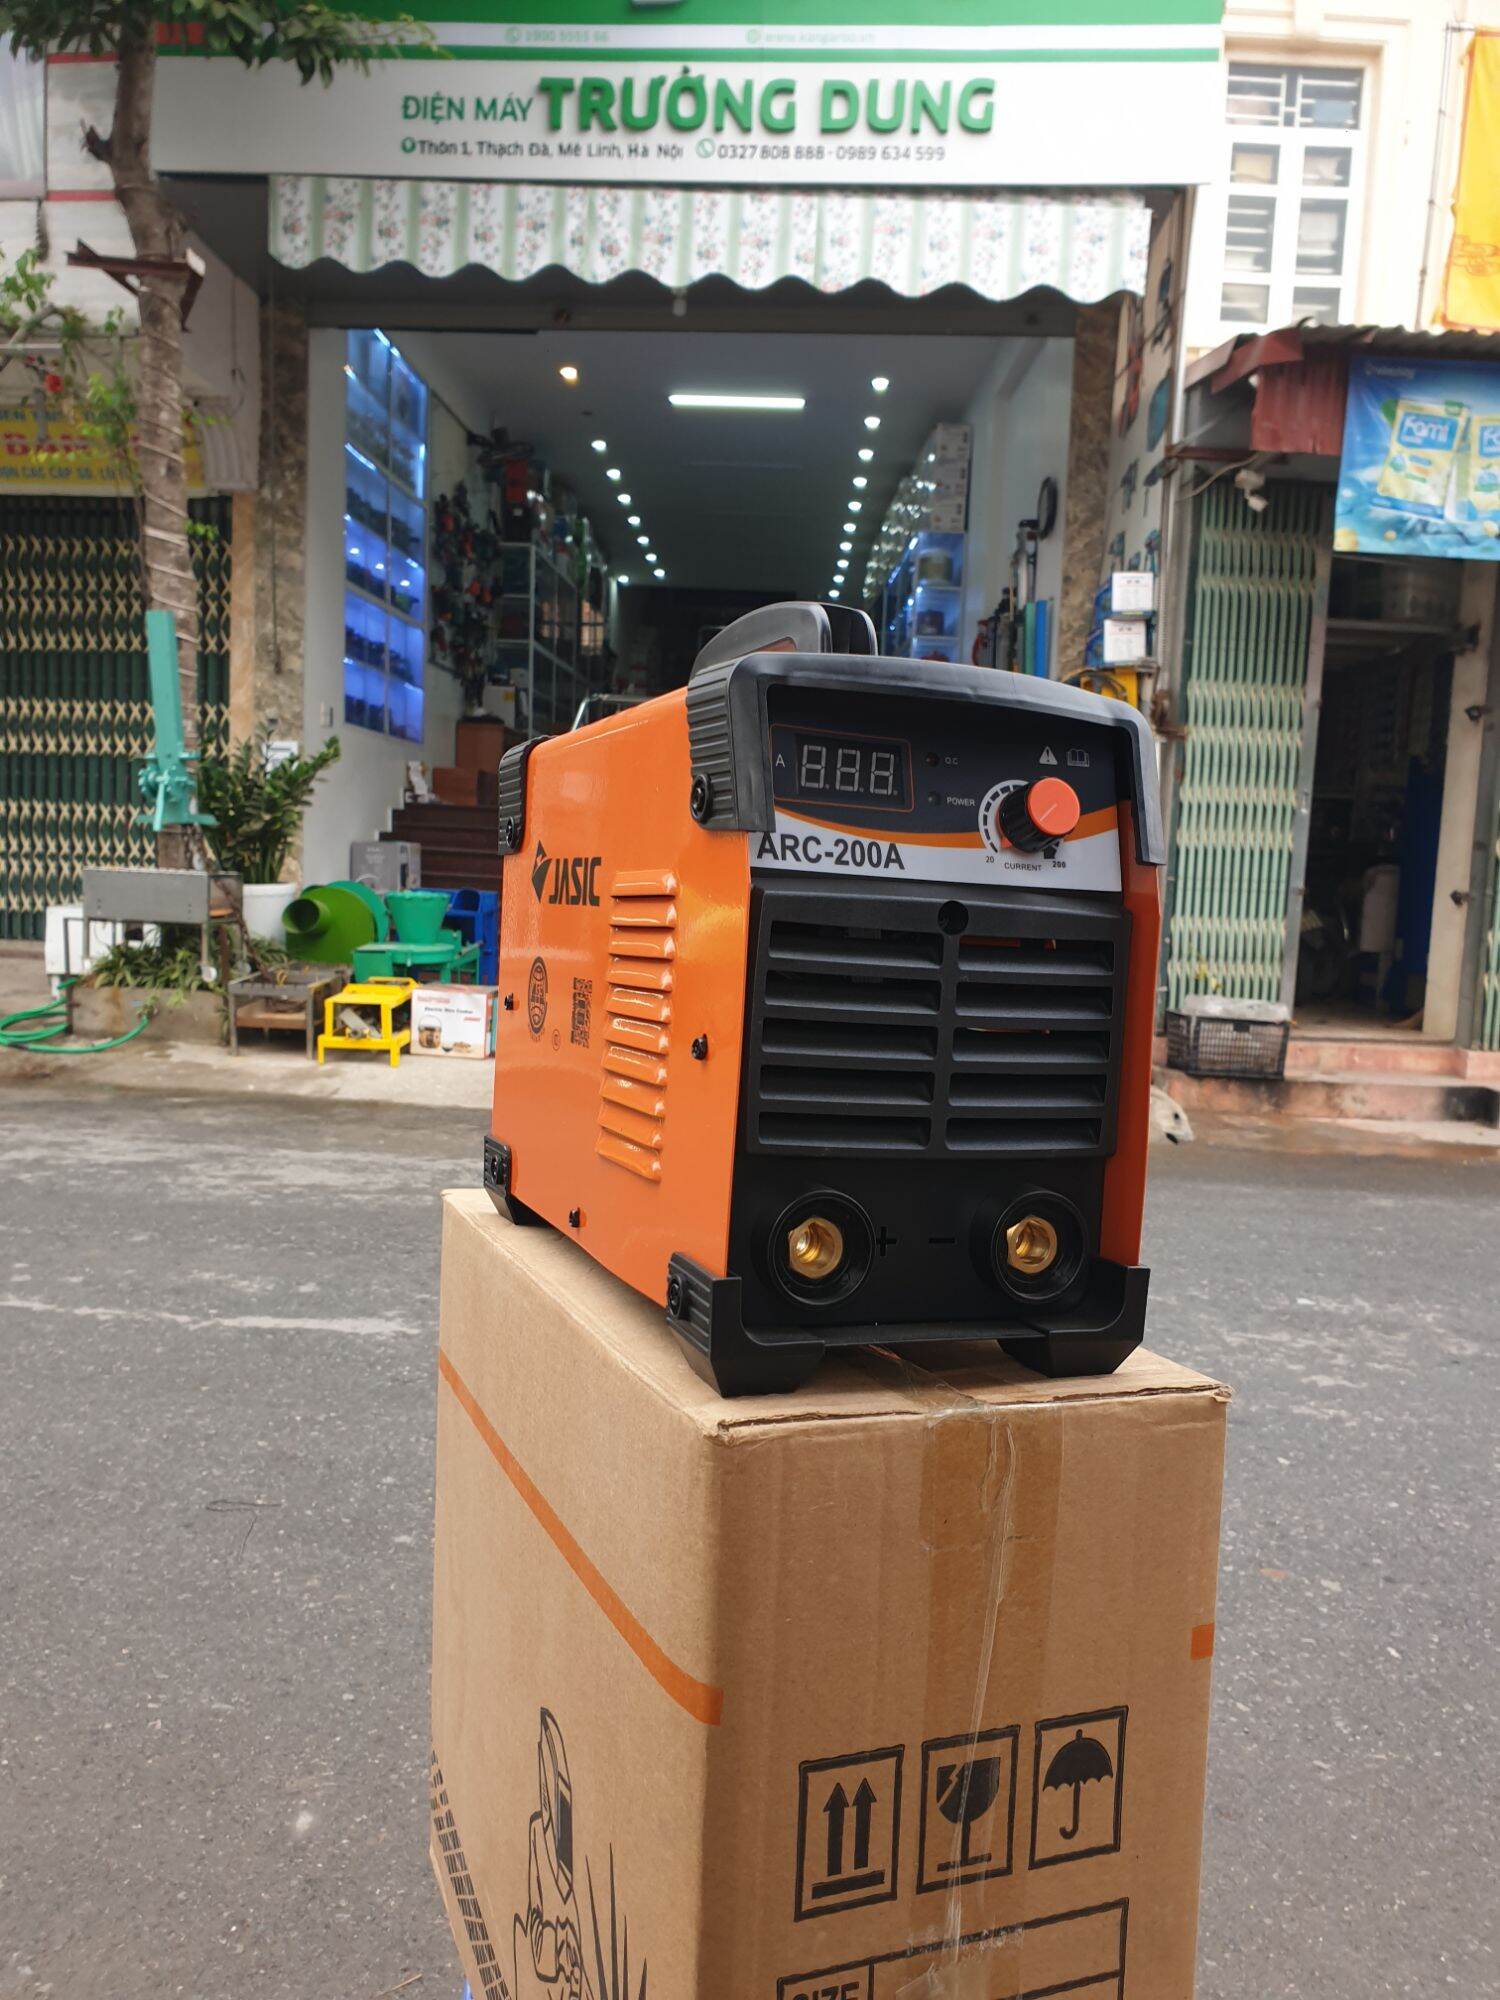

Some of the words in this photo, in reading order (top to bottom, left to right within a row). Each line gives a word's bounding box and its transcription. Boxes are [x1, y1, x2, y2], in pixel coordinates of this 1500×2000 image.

[401, 90, 466, 125] ĐIỆN
[474, 92, 533, 122] MÁY
[537, 65, 797, 135] TRƯỜNG
[820, 77, 996, 136] DUNG
[418, 140, 458, 156] Thôn
[477, 141, 524, 160] Thạch
[558, 142, 582, 157] Mê
[656, 142, 684, 161] Nội
[775, 753, 786, 768] A
[946, 796, 976, 807] POWER
[756, 831, 906, 871] ARC-200A
[985, 855, 995, 864] 20
[1003, 862, 1043, 872] CURRENT
[548, 856, 602, 907] JASIC
